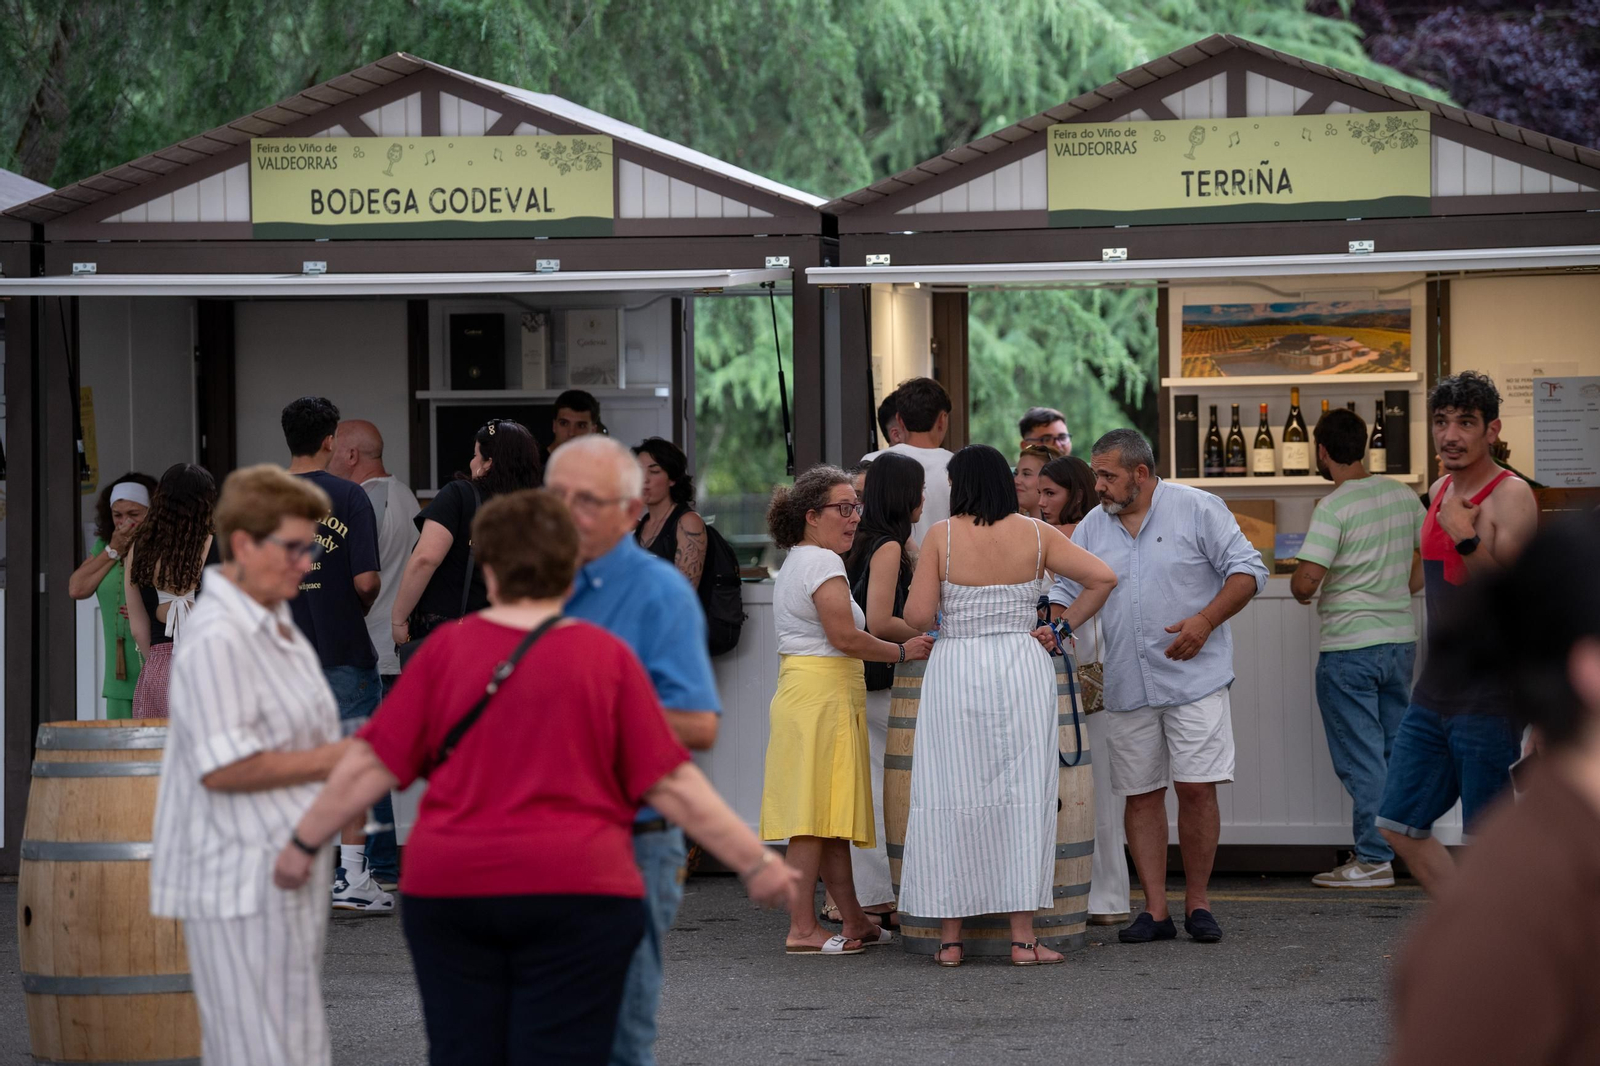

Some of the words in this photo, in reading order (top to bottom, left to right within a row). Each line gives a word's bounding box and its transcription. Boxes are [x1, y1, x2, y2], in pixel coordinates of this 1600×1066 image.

[1053, 129, 1078, 139] Feira
[1081, 128, 1095, 139] do
[1096, 127, 1121, 138] Viño
[1122, 127, 1137, 138] de
[256, 143, 280, 153] Feira
[282, 143, 296, 153] do
[298, 142, 321, 153] Viño
[323, 143, 337, 153] de
[1054, 140, 1137, 157] VALDEORRAS
[258, 155, 338, 171] VALDEORRAS
[1181, 160, 1293, 197] TERRIÑA
[310, 188, 420, 215] BODEGA
[428, 187, 555, 214] GODEVAL
